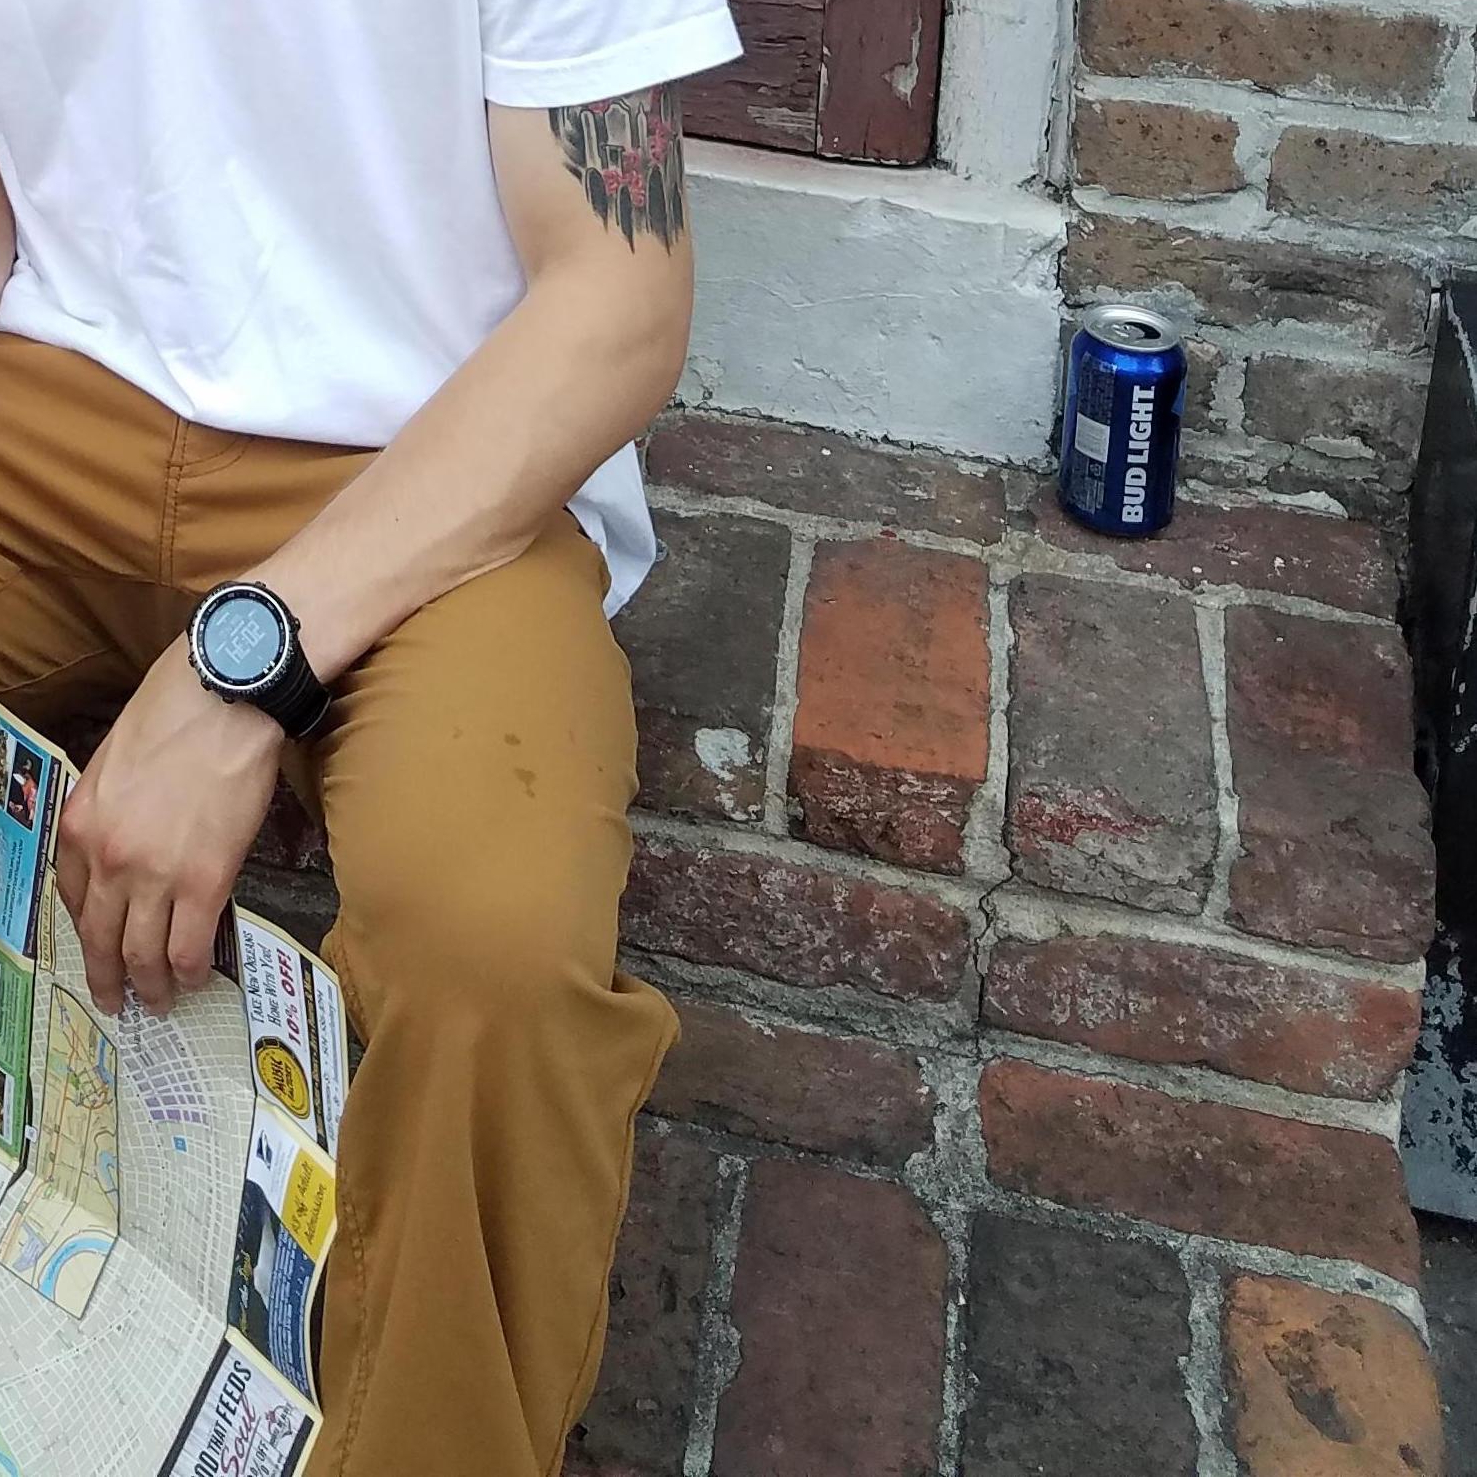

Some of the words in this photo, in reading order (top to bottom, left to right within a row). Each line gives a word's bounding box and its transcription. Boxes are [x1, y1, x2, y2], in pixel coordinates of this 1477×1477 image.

[1126, 385, 1156, 464] LIGHT
[1121, 466, 1147, 523] BUD
[243, 930, 258, 973] ORLEANS
[257, 943, 275, 969] YOU!
[277, 949, 296, 996] OFF!
[247, 974, 262, 998] NEW
[263, 971, 278, 997] WITH
[251, 997, 265, 1023] TAKE
[268, 998, 281, 1027] HOME
[285, 1004, 301, 1046] 10%
[216, 1360, 252, 1427] FEEDS
[207, 1420, 228, 1456] THAT
[220, 1391, 256, 1477] Soul
